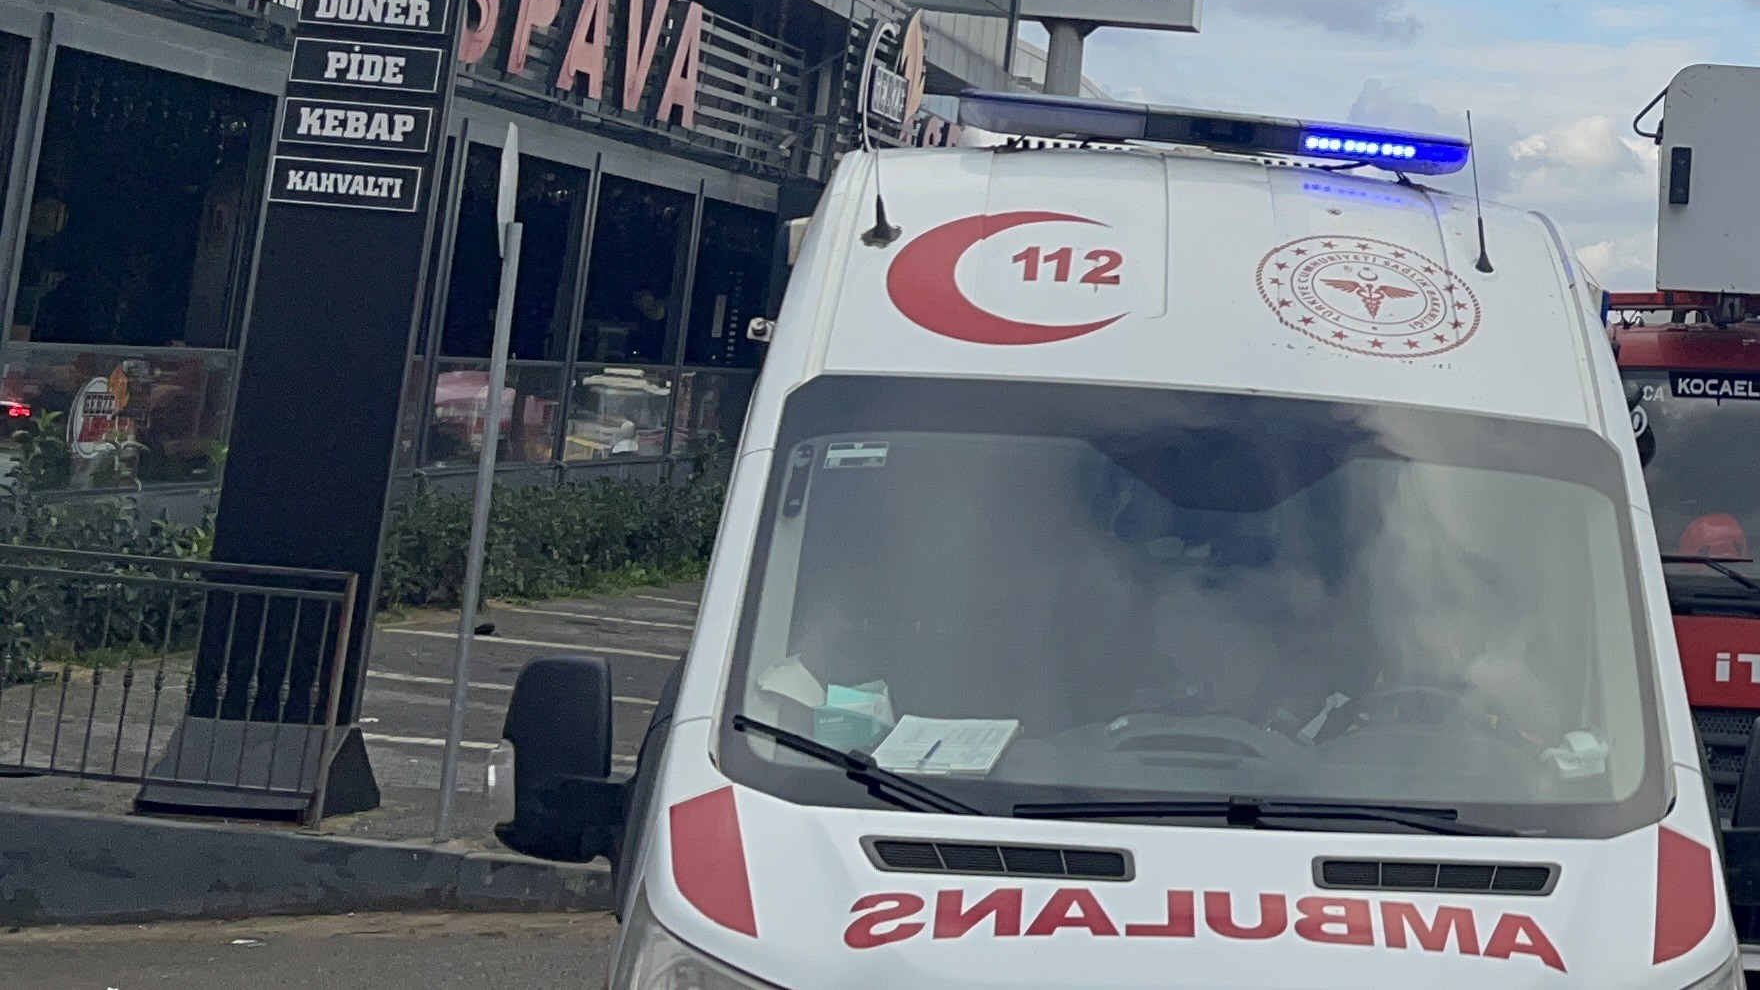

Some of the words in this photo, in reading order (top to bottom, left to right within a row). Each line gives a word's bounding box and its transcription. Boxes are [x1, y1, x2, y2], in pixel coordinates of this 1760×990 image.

[323, 47, 407, 85] PİDE
[297, 107, 415, 143] KEBAP
[286, 170, 403, 199] KAHVALTI
[1011, 246, 1124, 286] 112
